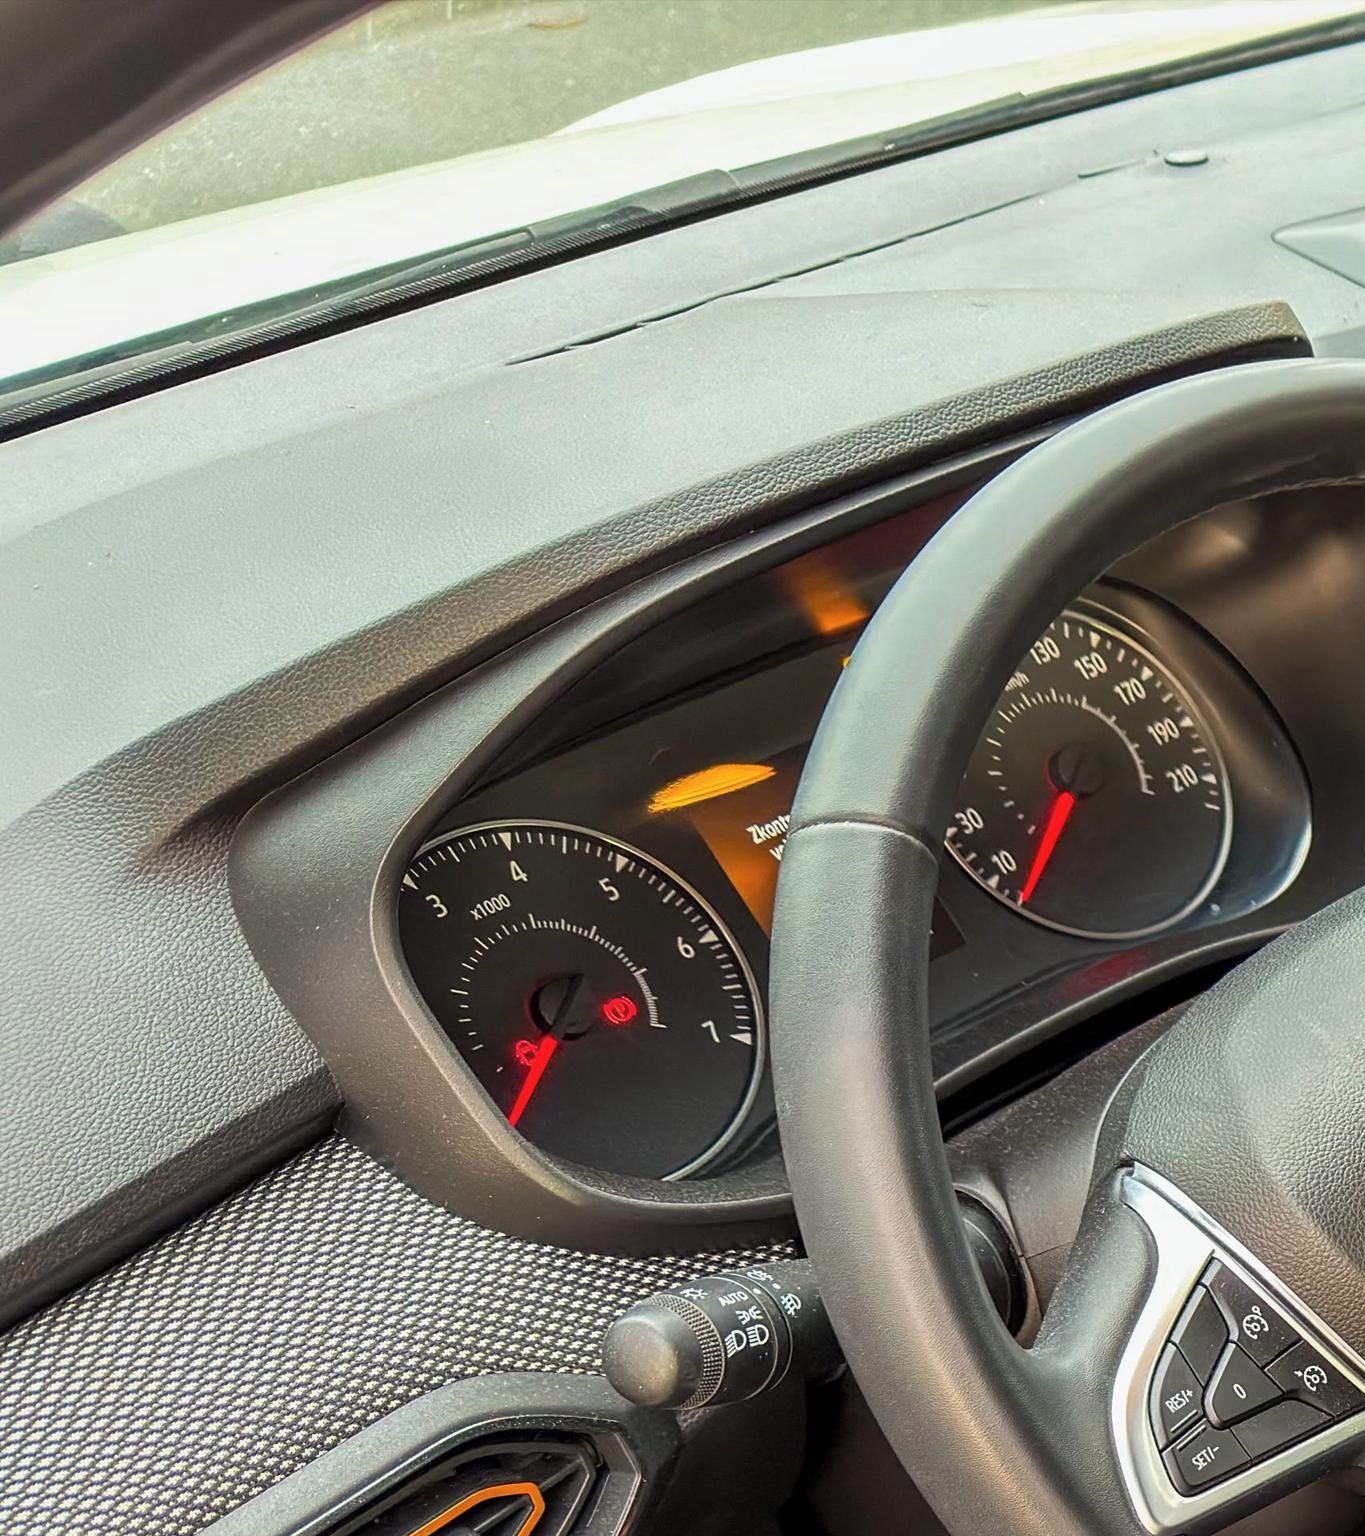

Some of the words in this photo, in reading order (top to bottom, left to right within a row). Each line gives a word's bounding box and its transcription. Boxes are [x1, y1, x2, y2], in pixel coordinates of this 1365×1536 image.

[1029, 636, 1061, 665] 130
[1074, 651, 1108, 681] 150
[1113, 677, 1147, 706] 170
[1147, 717, 1181, 746] 190
[1166, 763, 1199, 793] 210
[955, 807, 984, 835] 30
[509, 860, 528, 884] 4
[991, 850, 1017, 875] 10
[599, 877, 620, 902] 5
[425, 894, 448, 918] 3
[469, 893, 511, 921] x1000
[676, 936, 695, 959] 6
[701, 1019, 721, 1044] 7
[718, 1291, 749, 1307] AUTO
[1165, 1389, 1194, 1414] RES/+
